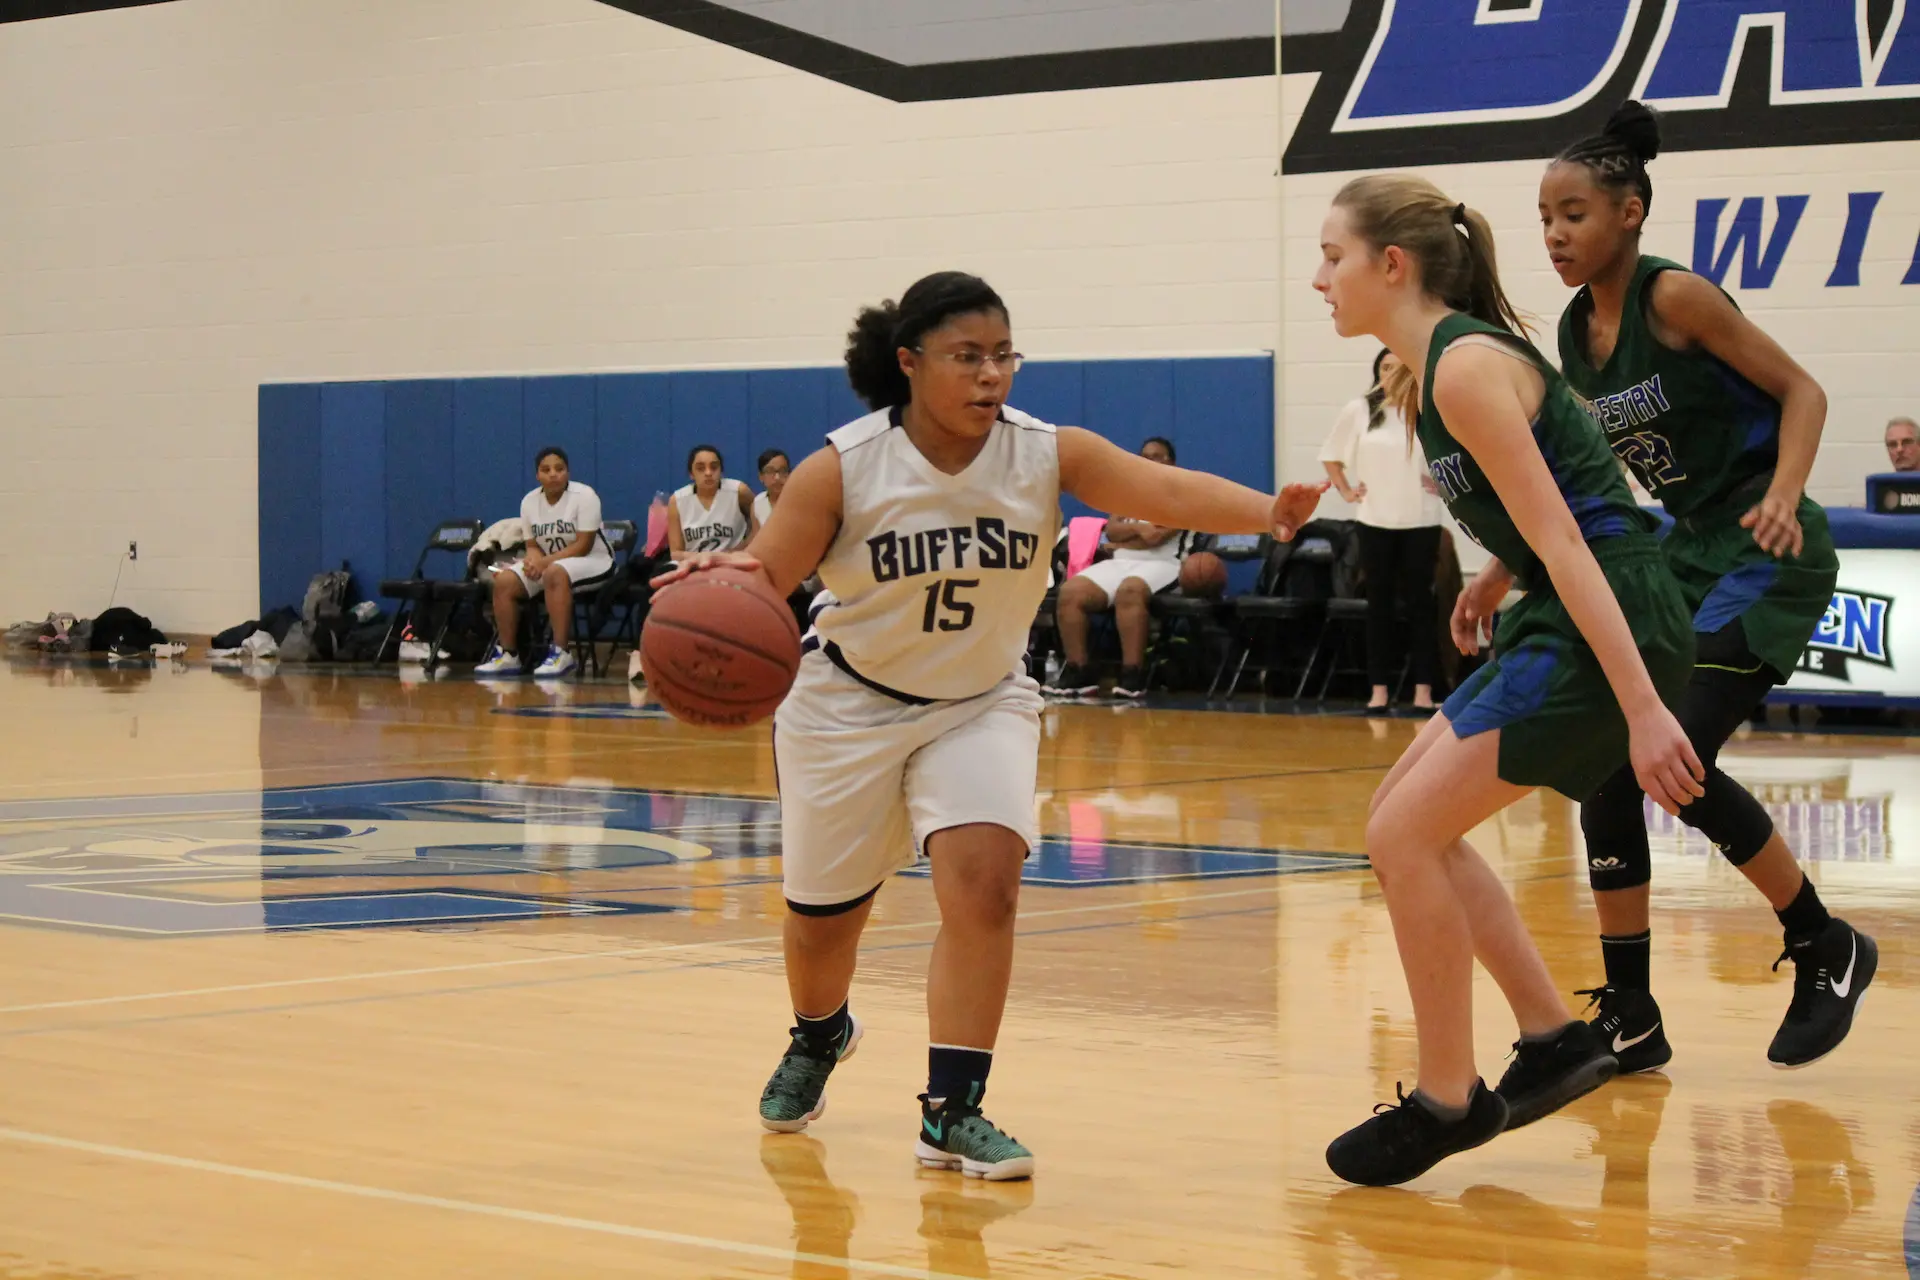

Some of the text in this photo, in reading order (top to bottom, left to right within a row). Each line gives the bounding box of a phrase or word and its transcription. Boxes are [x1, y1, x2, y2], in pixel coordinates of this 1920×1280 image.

[1692, 191, 1920, 290] WI
[1431, 452, 1472, 502] RY
[923, 578, 980, 633] 15
[1807, 592, 1887, 661] EN
